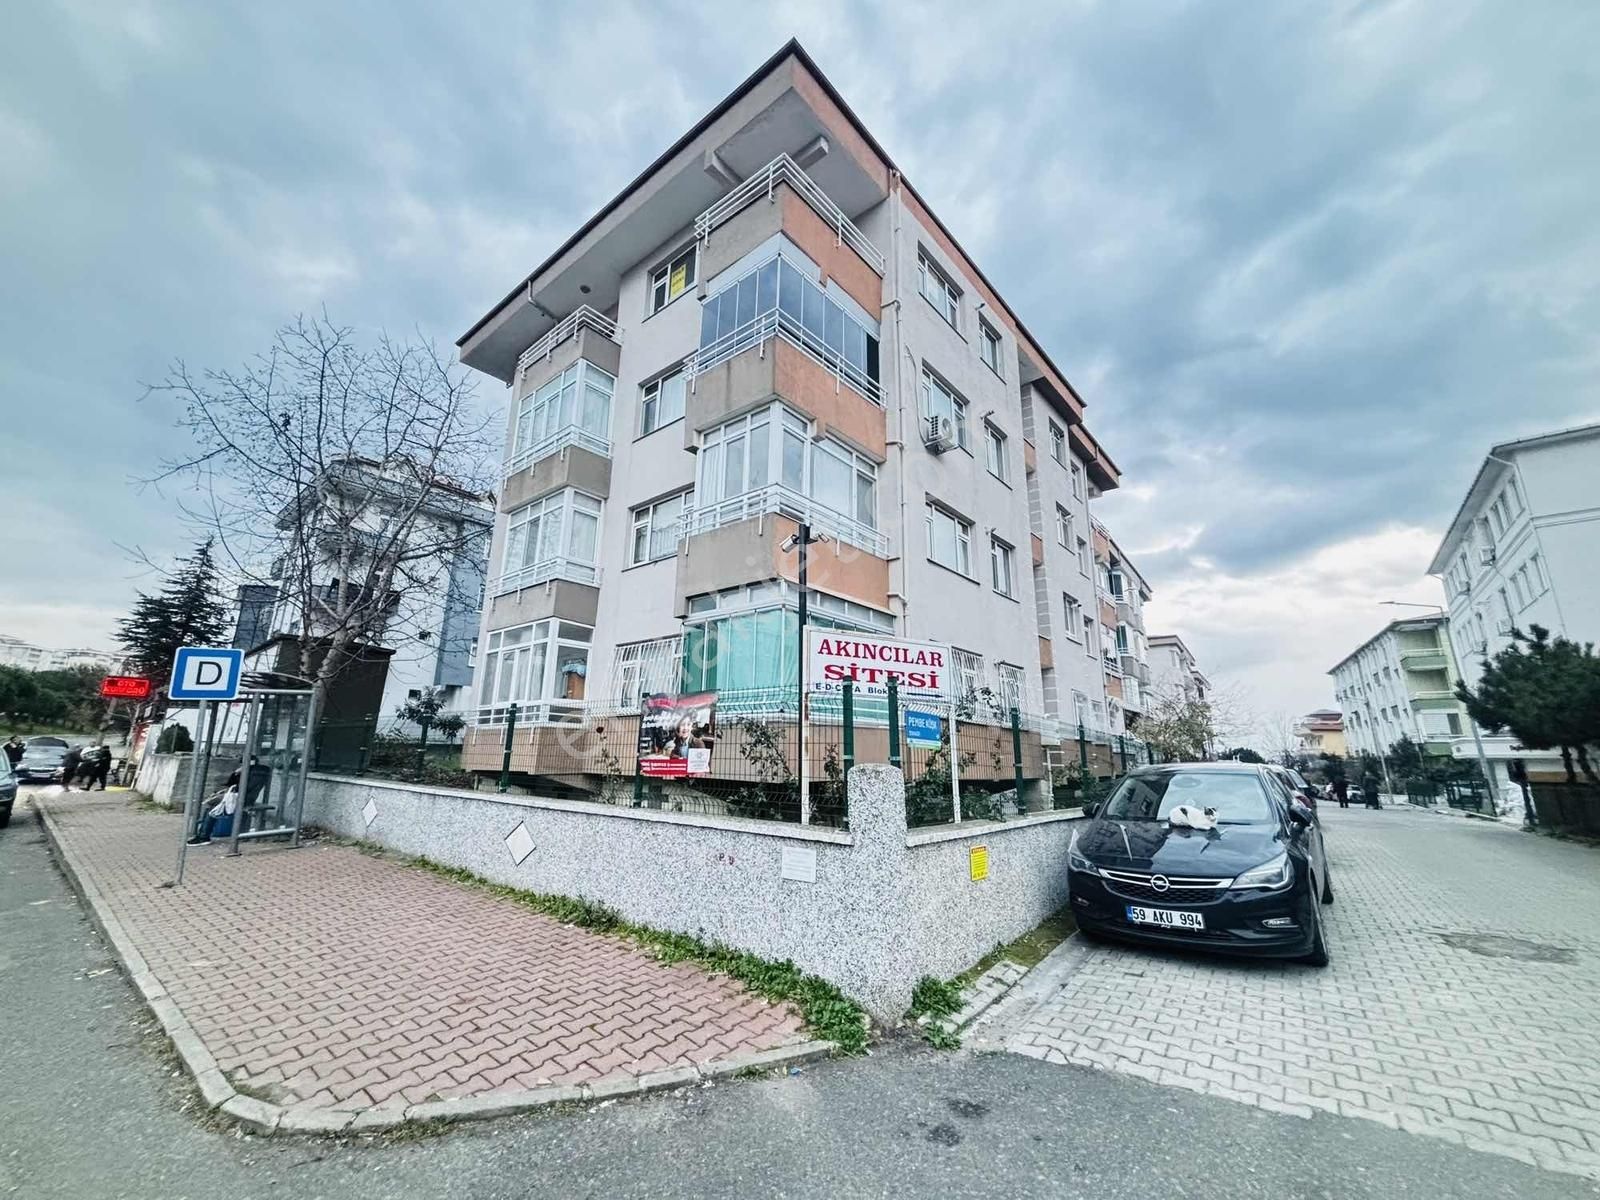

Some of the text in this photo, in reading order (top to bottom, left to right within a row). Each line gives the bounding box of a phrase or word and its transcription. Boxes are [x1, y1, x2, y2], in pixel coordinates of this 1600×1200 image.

[817, 638, 944, 667] AKINCILAR
[195, 661, 223, 685] D
[824, 663, 940, 689] SİTESİ
[1132, 908, 1202, 927] 59 AKU 994
